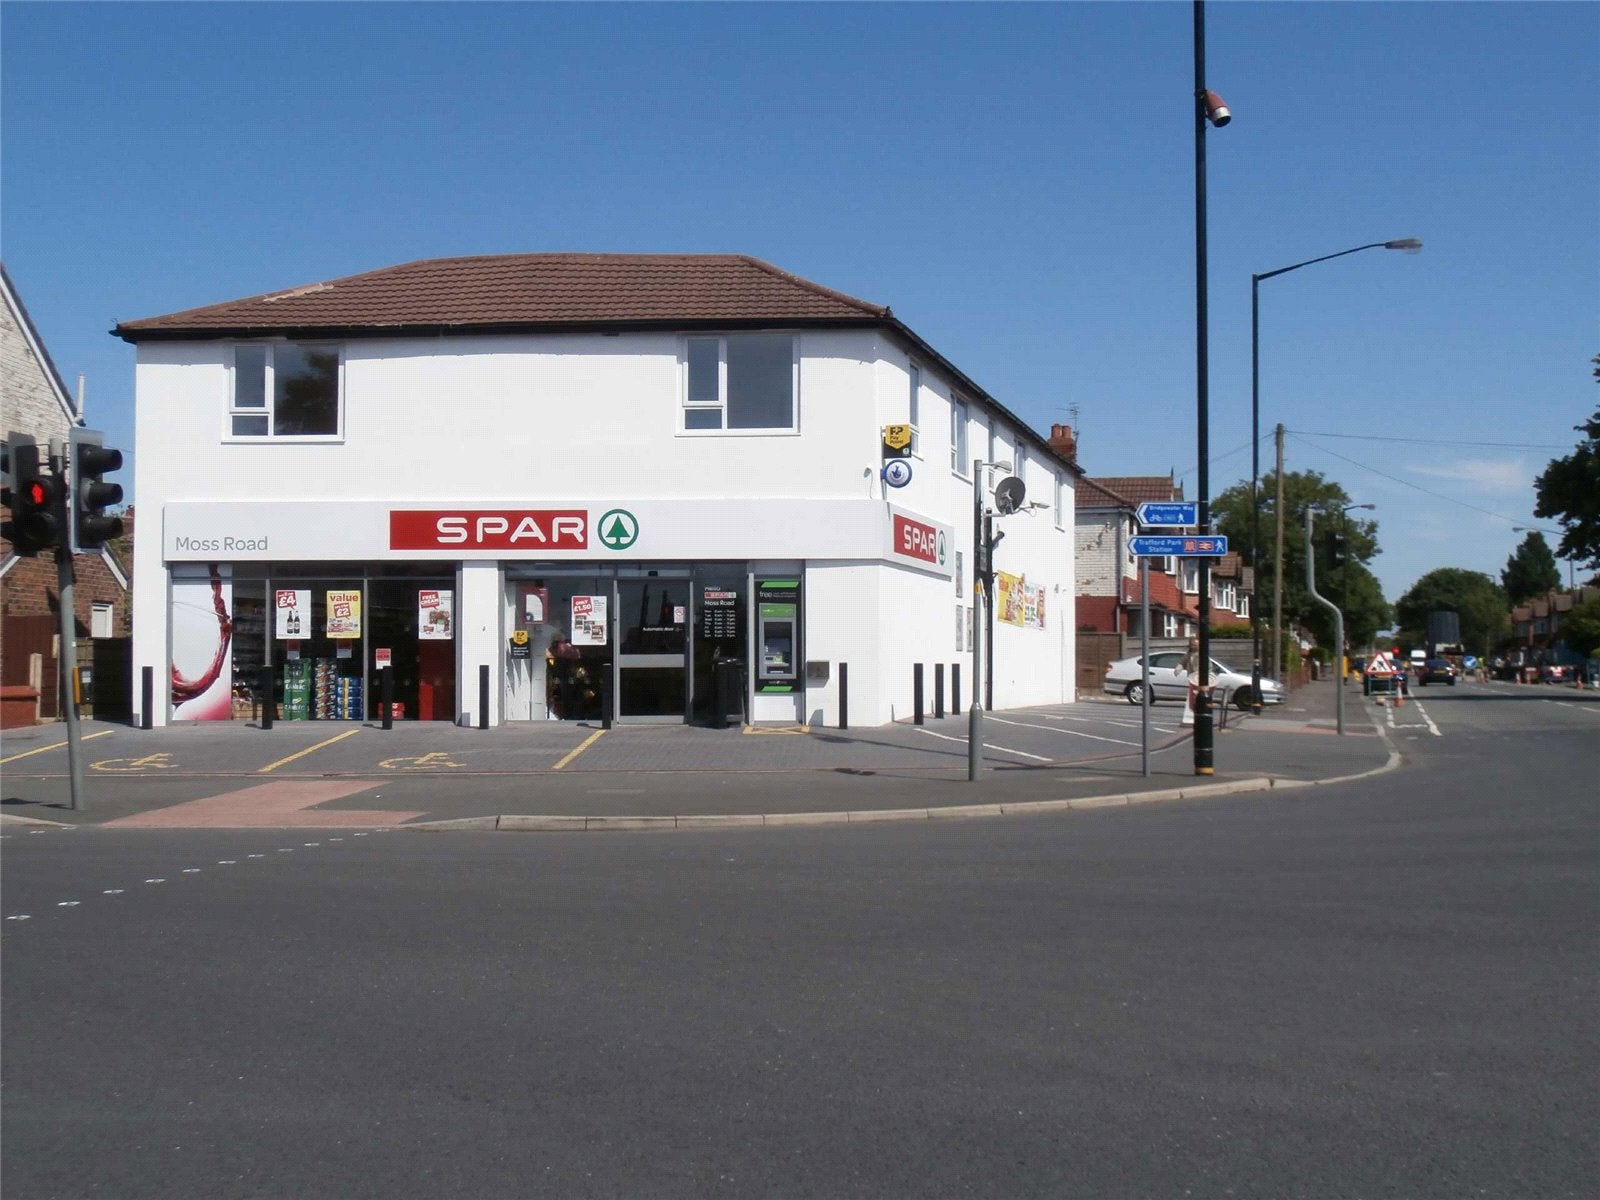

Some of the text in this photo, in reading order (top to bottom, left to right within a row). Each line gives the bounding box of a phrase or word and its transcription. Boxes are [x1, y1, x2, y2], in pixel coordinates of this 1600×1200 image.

[437, 517, 585, 543] SPAR
[176, 536, 268, 551] Moss Road
[904, 524, 936, 557] SPAR
[279, 595, 296, 607] £4
[330, 593, 359, 602] value
[336, 608, 349, 617] £2
[573, 603, 592, 612] £1.50
